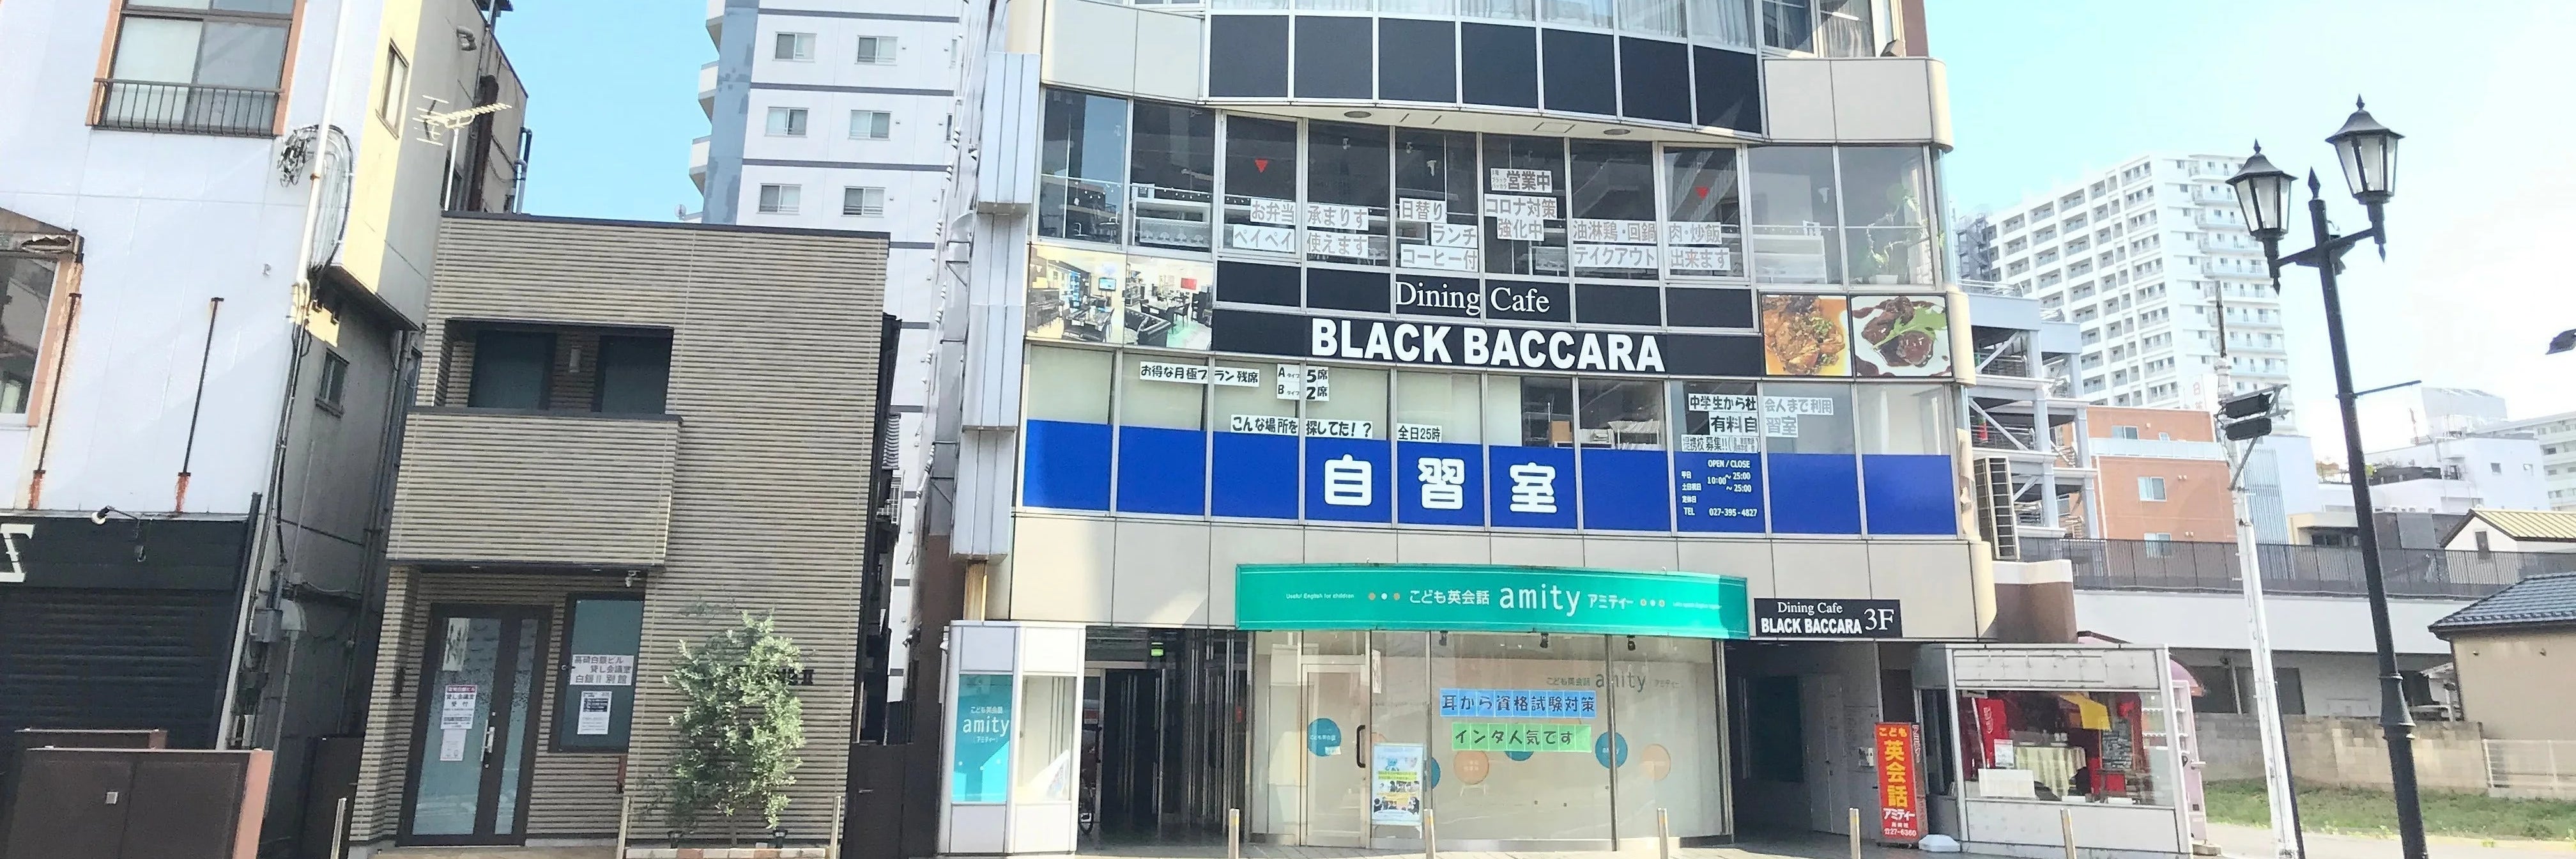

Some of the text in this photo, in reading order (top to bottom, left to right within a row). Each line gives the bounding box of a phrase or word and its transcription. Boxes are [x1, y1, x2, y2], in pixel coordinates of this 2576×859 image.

[1507, 170, 1550, 190] 営業中
[1402, 200, 1443, 221] 日替り
[1485, 197, 1556, 218] コロナ対策
[1433, 225, 1476, 245] ランチ
[1498, 218, 1542, 239] 強化中
[1402, 249, 1477, 270] コーヒー付
[1396, 281, 1550, 316] Dining Cafe
[1312, 318, 1665, 372] BLACK BACCARA
[1397, 426, 1441, 442] 全日25時
[1324, 454, 1558, 514] 自習室
[1683, 507, 1695, 516] TEL
[1409, 583, 1634, 617] こども英会話 amity アミティー
[1777, 601, 1843, 615] Dining Cafe
[1761, 617, 1862, 634] BLACK BACCARA
[1864, 608, 1895, 630] 3F
[1442, 695, 1595, 712] 耳から資格試験対策
[962, 715, 1009, 738] amity
[1455, 729, 1573, 745] インタ人気です
[1878, 727, 1908, 738] こども
[1883, 739, 1908, 808] 英会話
[1883, 808, 1915, 821] アミティー
